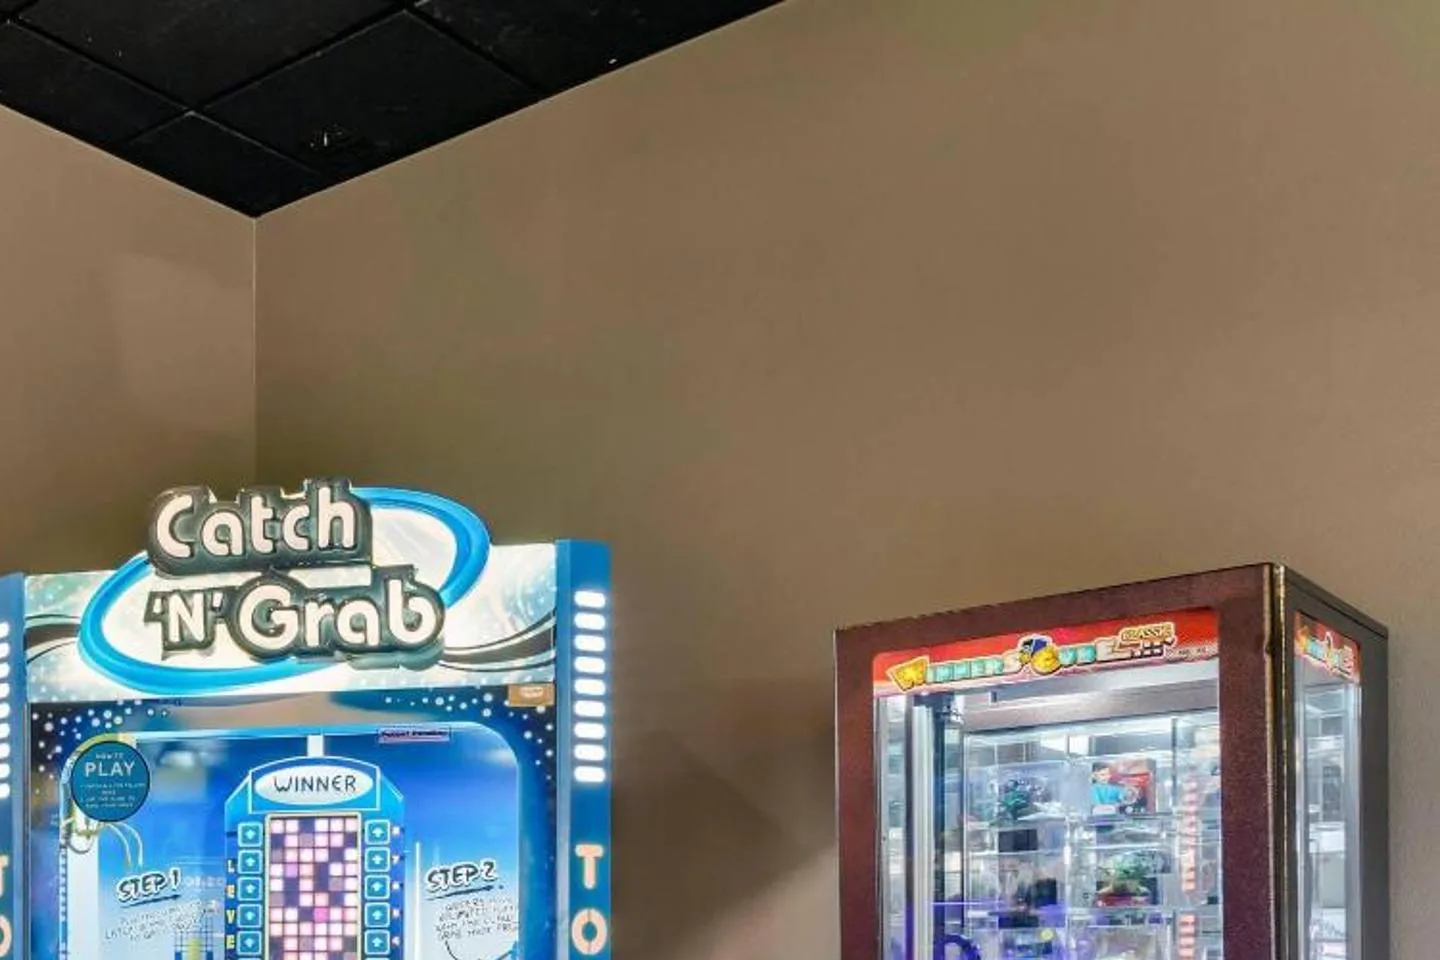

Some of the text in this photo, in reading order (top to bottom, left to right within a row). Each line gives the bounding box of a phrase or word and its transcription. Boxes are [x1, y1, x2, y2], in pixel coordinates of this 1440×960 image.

[156, 486, 356, 559] Catch
[239, 579, 438, 650] Grab
[84, 761, 136, 777] PLAY
[273, 774, 356, 792] WINNER
[117, 872, 166, 899] STEP
[427, 861, 495, 888] STEP 2
